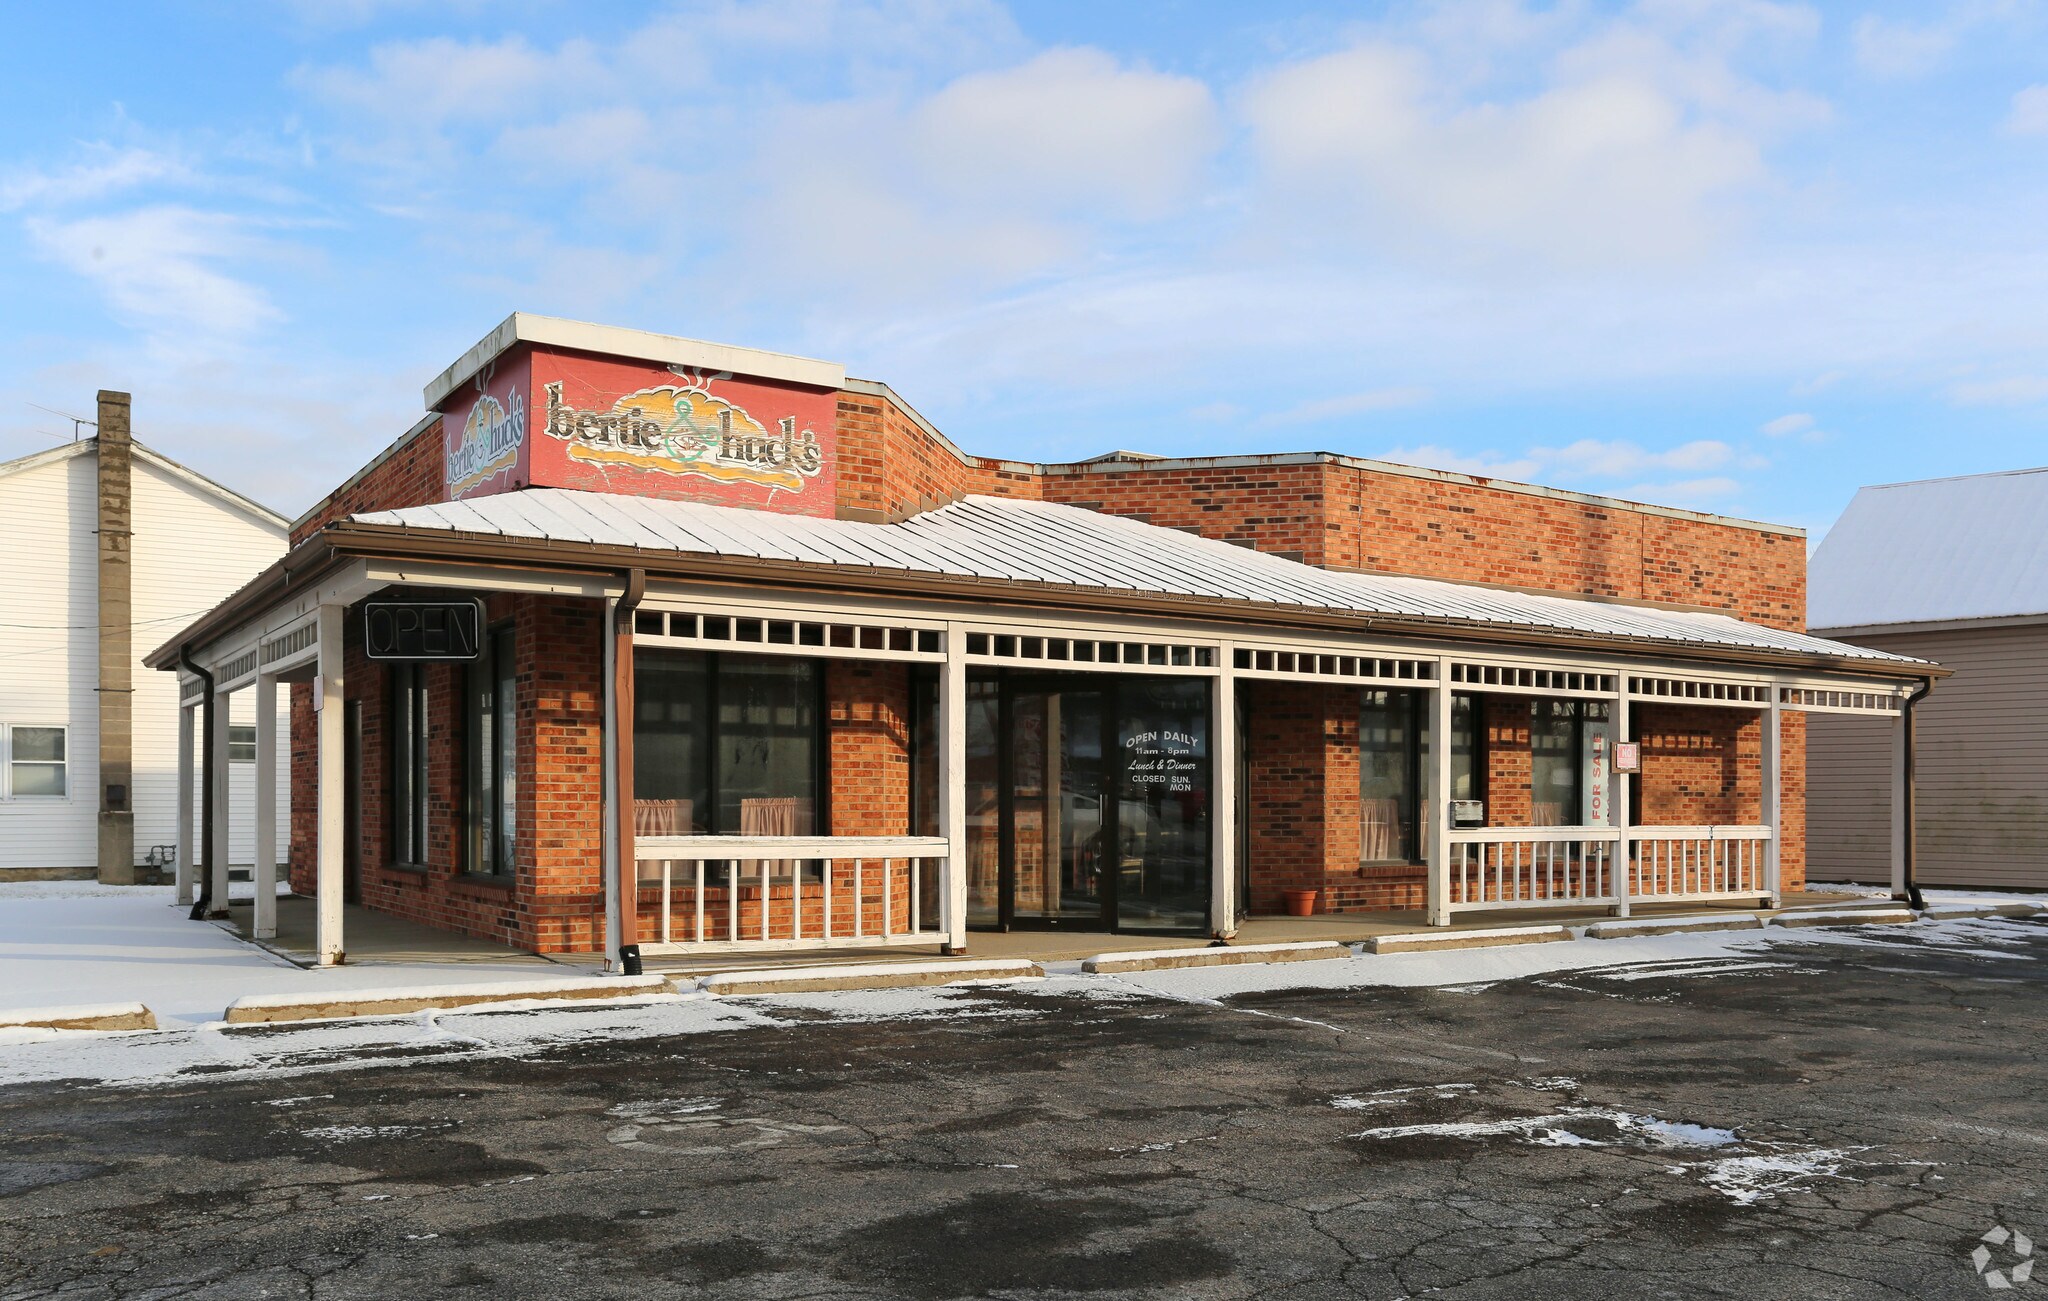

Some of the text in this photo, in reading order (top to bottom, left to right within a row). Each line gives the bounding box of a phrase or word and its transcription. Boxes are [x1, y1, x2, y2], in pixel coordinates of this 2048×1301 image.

[543, 380, 661, 450] bertie
[664, 400, 721, 462] &
[446, 434, 475, 482] bertie
[370, 608, 473, 653] OPEN
[1126, 731, 1198, 748] OPEN DAILY
[1135, 747, 1158, 755] 11am
[1167, 747, 1189, 756] 8pm
[1128, 759, 1196, 770] Lunch & Dinner
[1132, 775, 1190, 784] CLOSED SUN.
[1592, 732, 1602, 820] FOR SALE
[1170, 784, 1191, 792] MON
